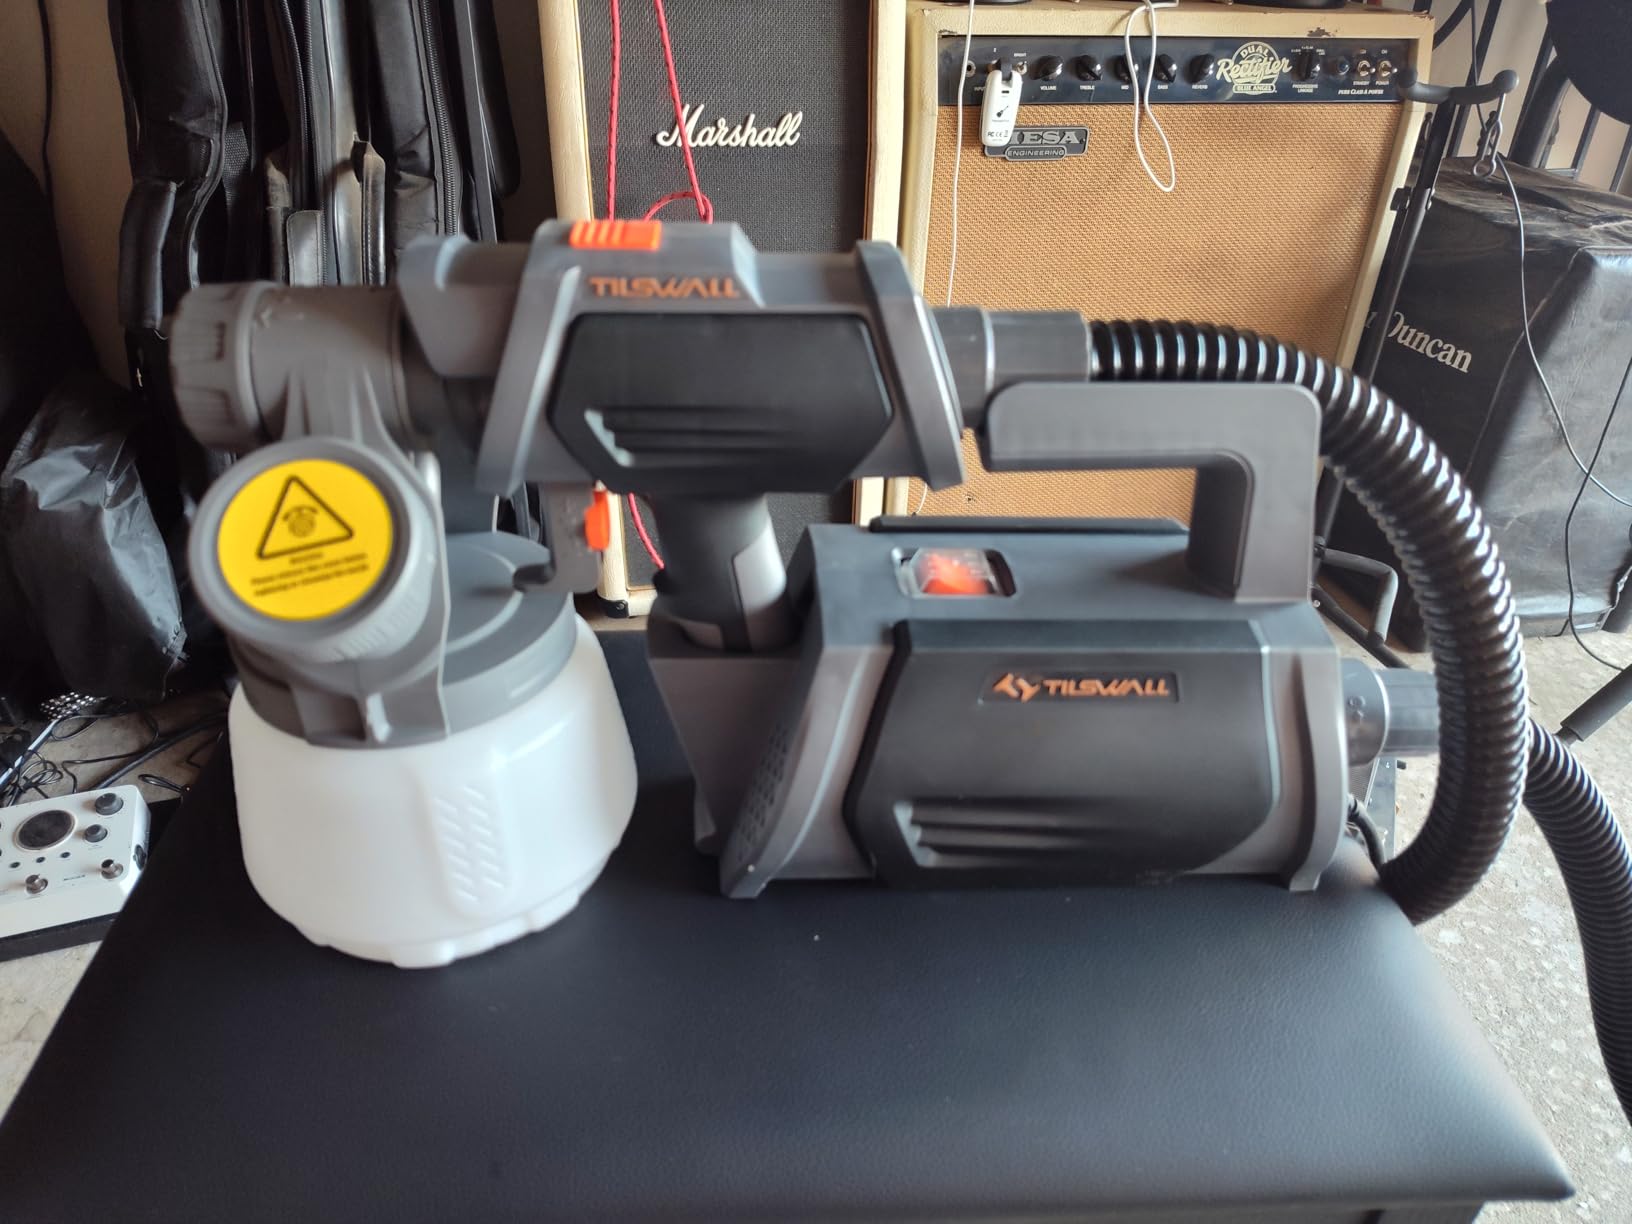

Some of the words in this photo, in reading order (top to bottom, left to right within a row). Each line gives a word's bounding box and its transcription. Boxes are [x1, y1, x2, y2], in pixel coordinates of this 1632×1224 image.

[1240, 45, 1269, 58] DUAL
[1216, 57, 1292, 83] Rectifier
[656, 103, 803, 148] Marshall
[1007, 149, 1065, 157] ENGINEERING
[589, 276, 739, 298] TILSWALL
[1043, 678, 1170, 697] TILSWALL
